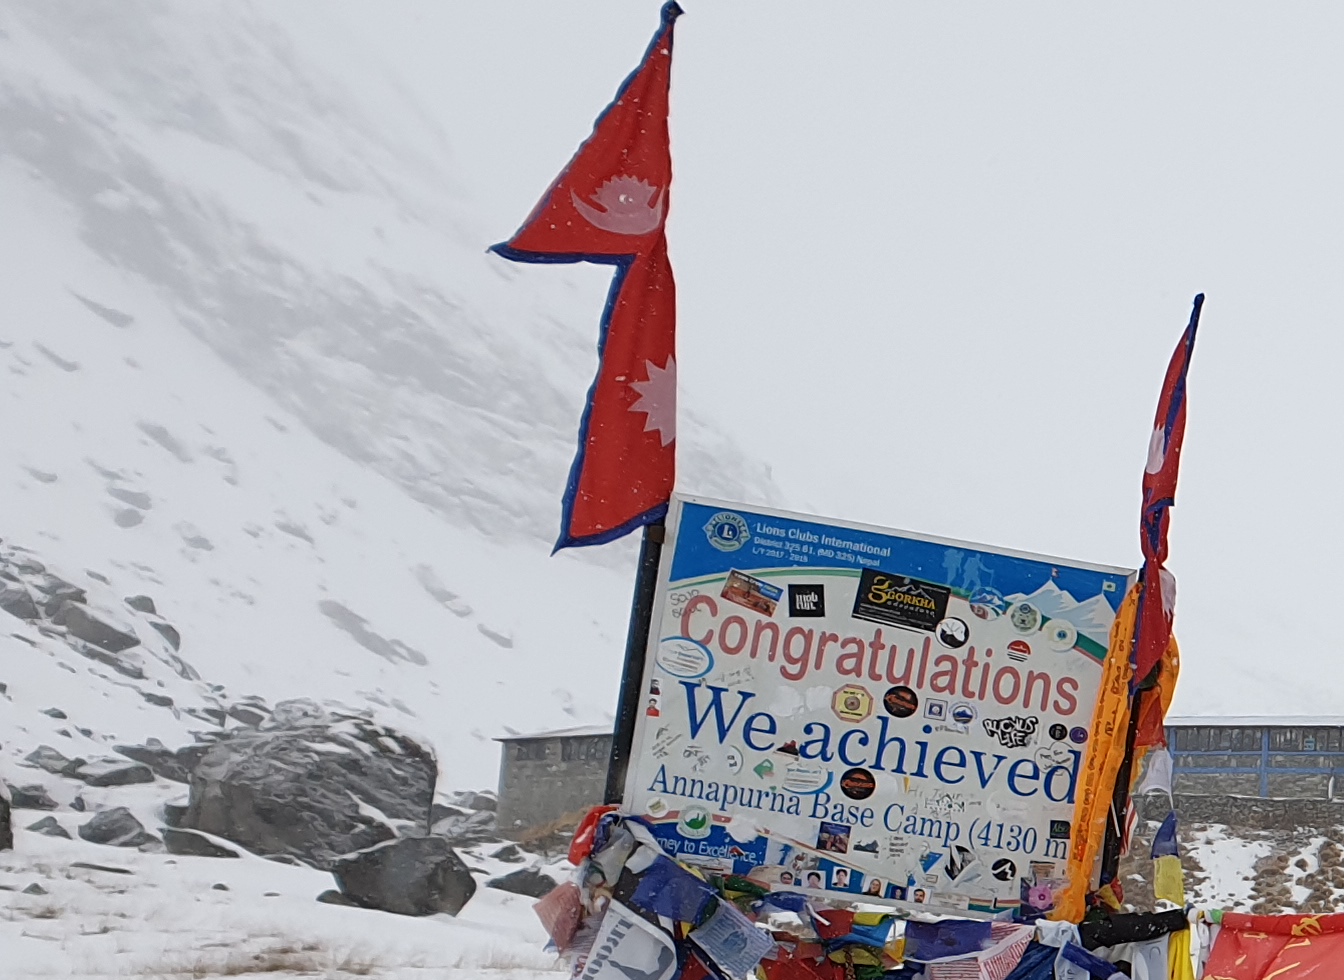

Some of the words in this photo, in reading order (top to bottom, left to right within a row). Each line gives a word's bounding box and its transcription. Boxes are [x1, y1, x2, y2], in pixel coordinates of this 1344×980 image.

[756, 522, 786, 538] Lions
[788, 528, 819, 543] Clubs
[821, 533, 892, 557] International
[886, 591, 937, 610] GORKHA
[681, 594, 1079, 716] Congratulations
[678, 681, 778, 752] We
[799, 715, 1082, 805] achieved
[647, 762, 802, 817] Annapurna
[808, 791, 875, 828] Base
[883, 803, 960, 848] Camp
[968, 817, 1038, 856] (4130
[684, 840, 696, 854] to
